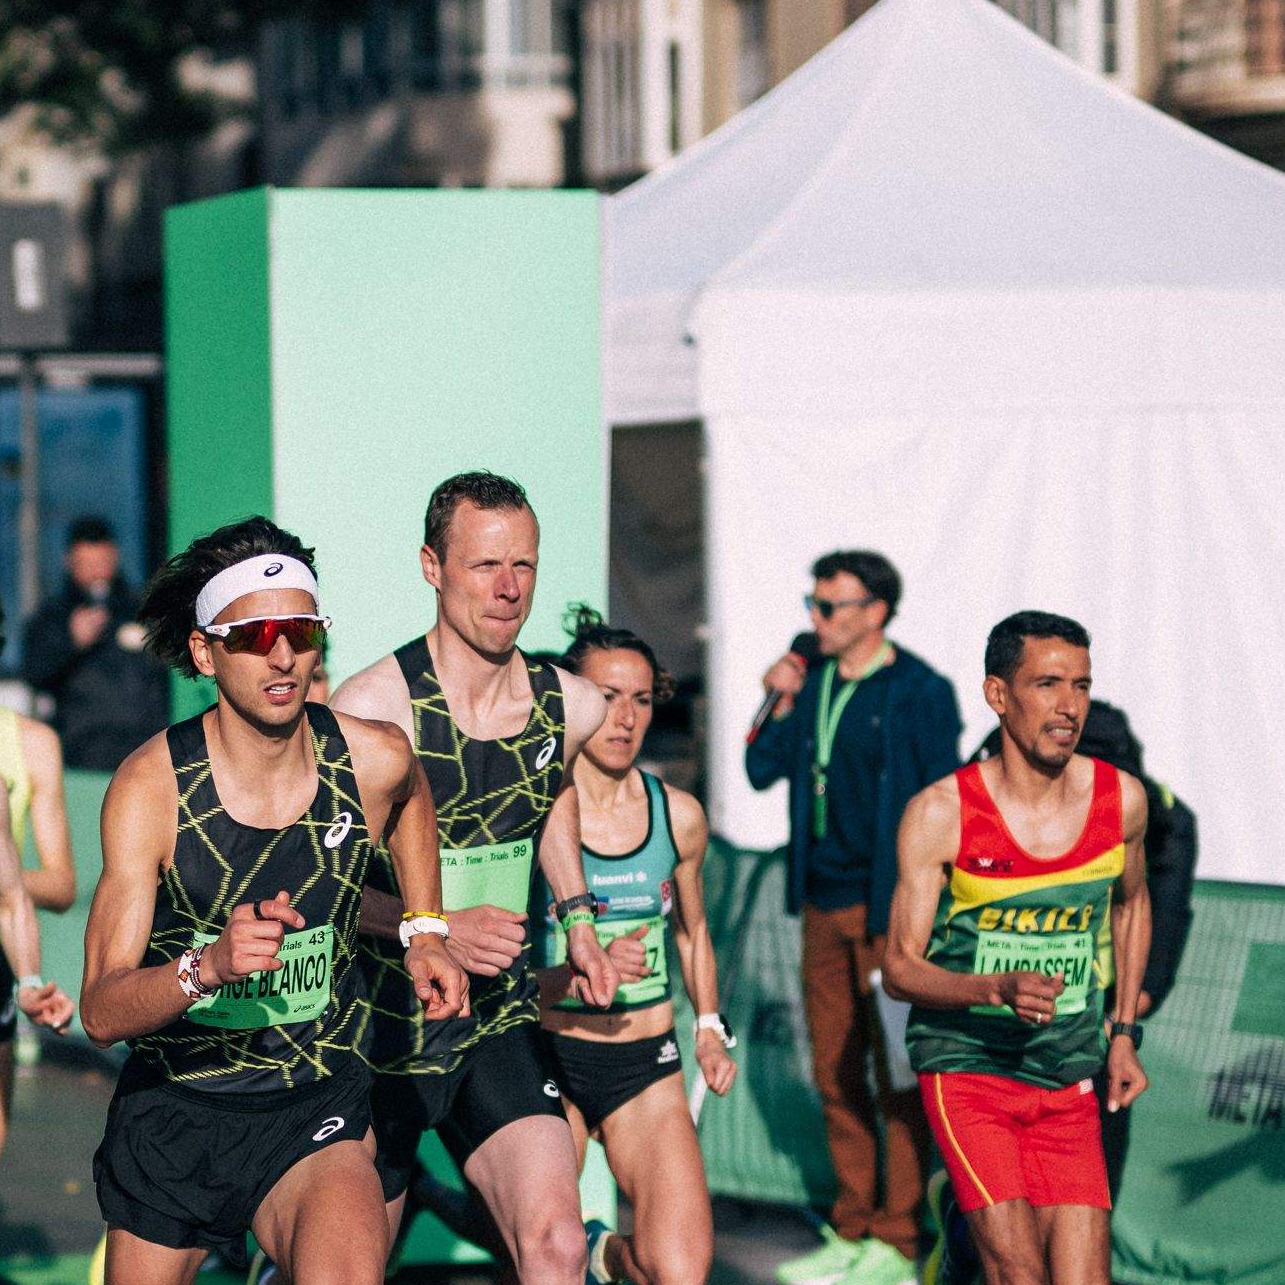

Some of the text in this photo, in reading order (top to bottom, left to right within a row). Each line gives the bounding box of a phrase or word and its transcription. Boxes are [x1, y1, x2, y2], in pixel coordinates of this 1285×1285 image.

[440, 857, 457, 867] ETA
[466, 855, 483, 865] Time
[513, 844, 527, 858] 99
[279, 930, 326, 952] rials 43
[1073, 939, 1086, 948] 41
[257, 952, 327, 999] BLANCO
